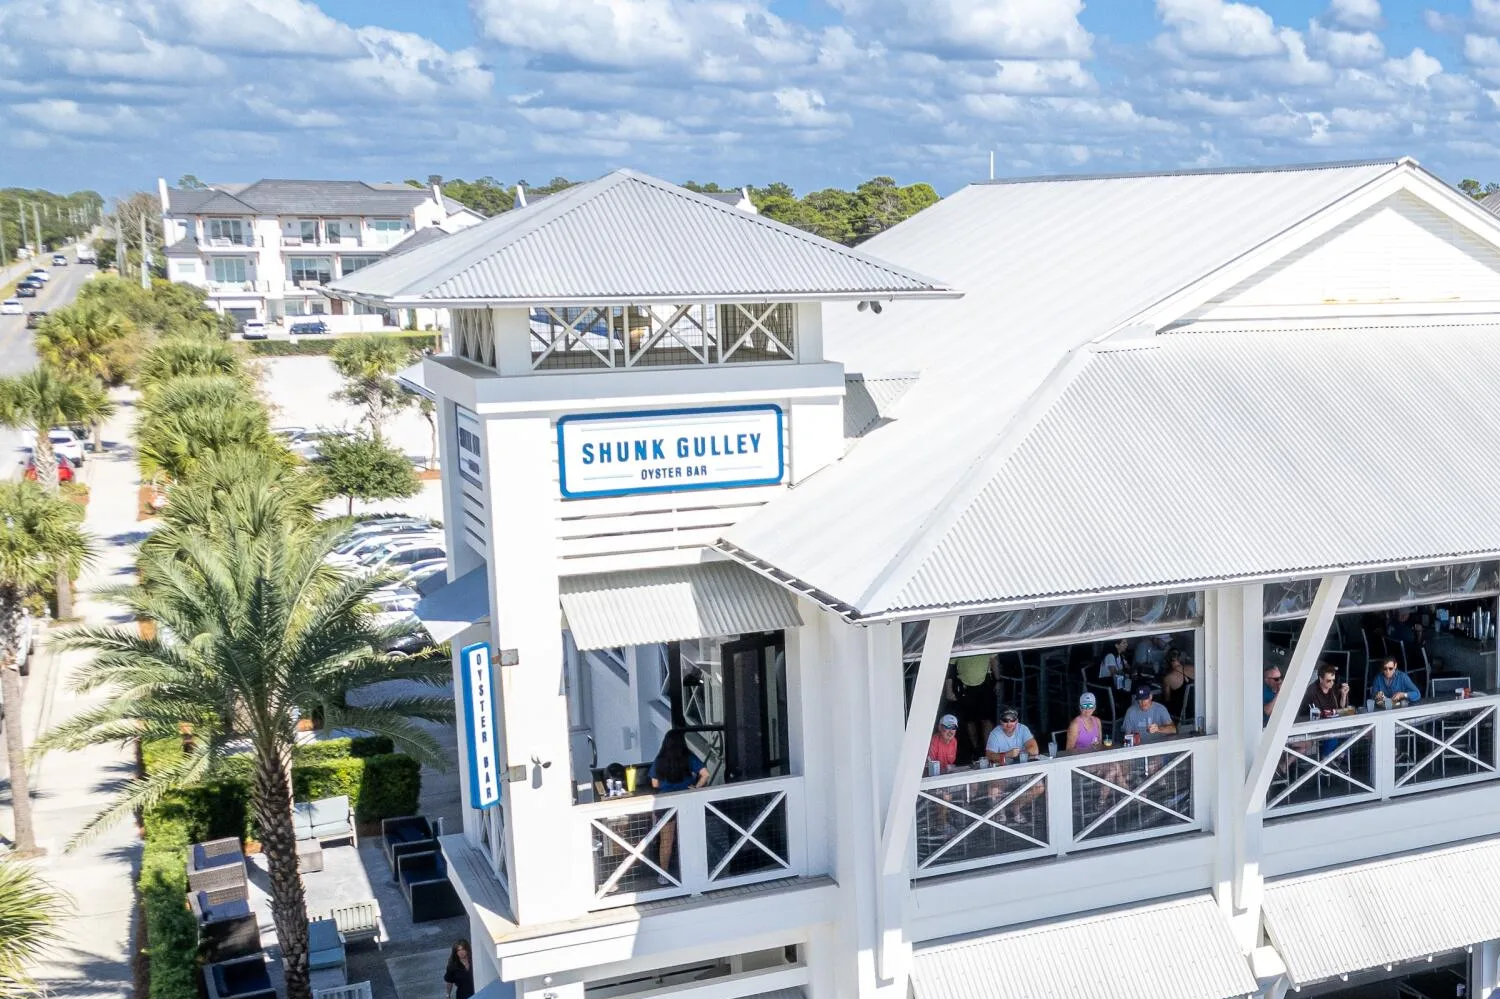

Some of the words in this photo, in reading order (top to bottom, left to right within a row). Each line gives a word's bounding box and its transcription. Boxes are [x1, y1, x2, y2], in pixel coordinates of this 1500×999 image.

[582, 438, 665, 465] SHUNK
[677, 433, 762, 458] GULLEY
[641, 467, 682, 480] OYSTER
[686, 465, 708, 477] BAR
[476, 653, 488, 743] OYSTER
[483, 756, 492, 799] BAR
